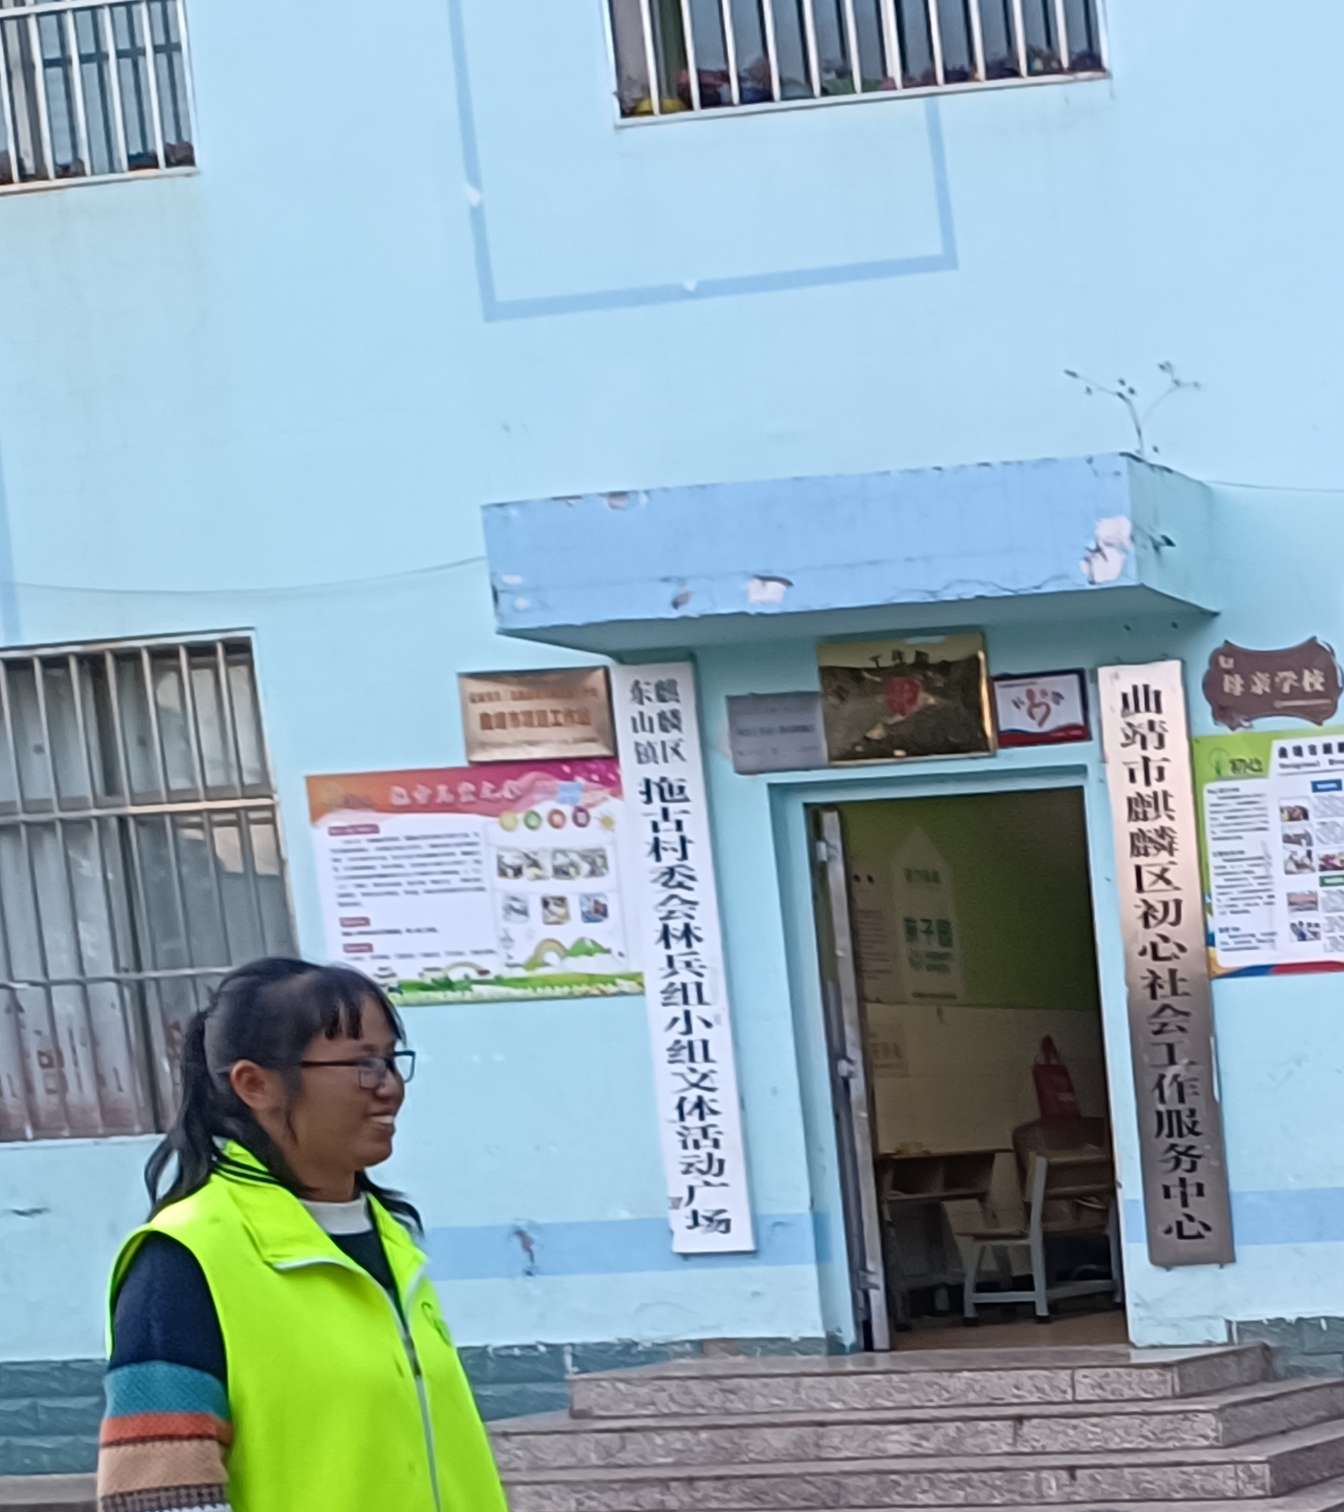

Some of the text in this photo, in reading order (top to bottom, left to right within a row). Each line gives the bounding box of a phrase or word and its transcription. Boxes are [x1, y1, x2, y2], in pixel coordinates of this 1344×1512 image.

[1118, 682, 1213, 1242] 曲靖市麒麟区初心社会工作服务中心
